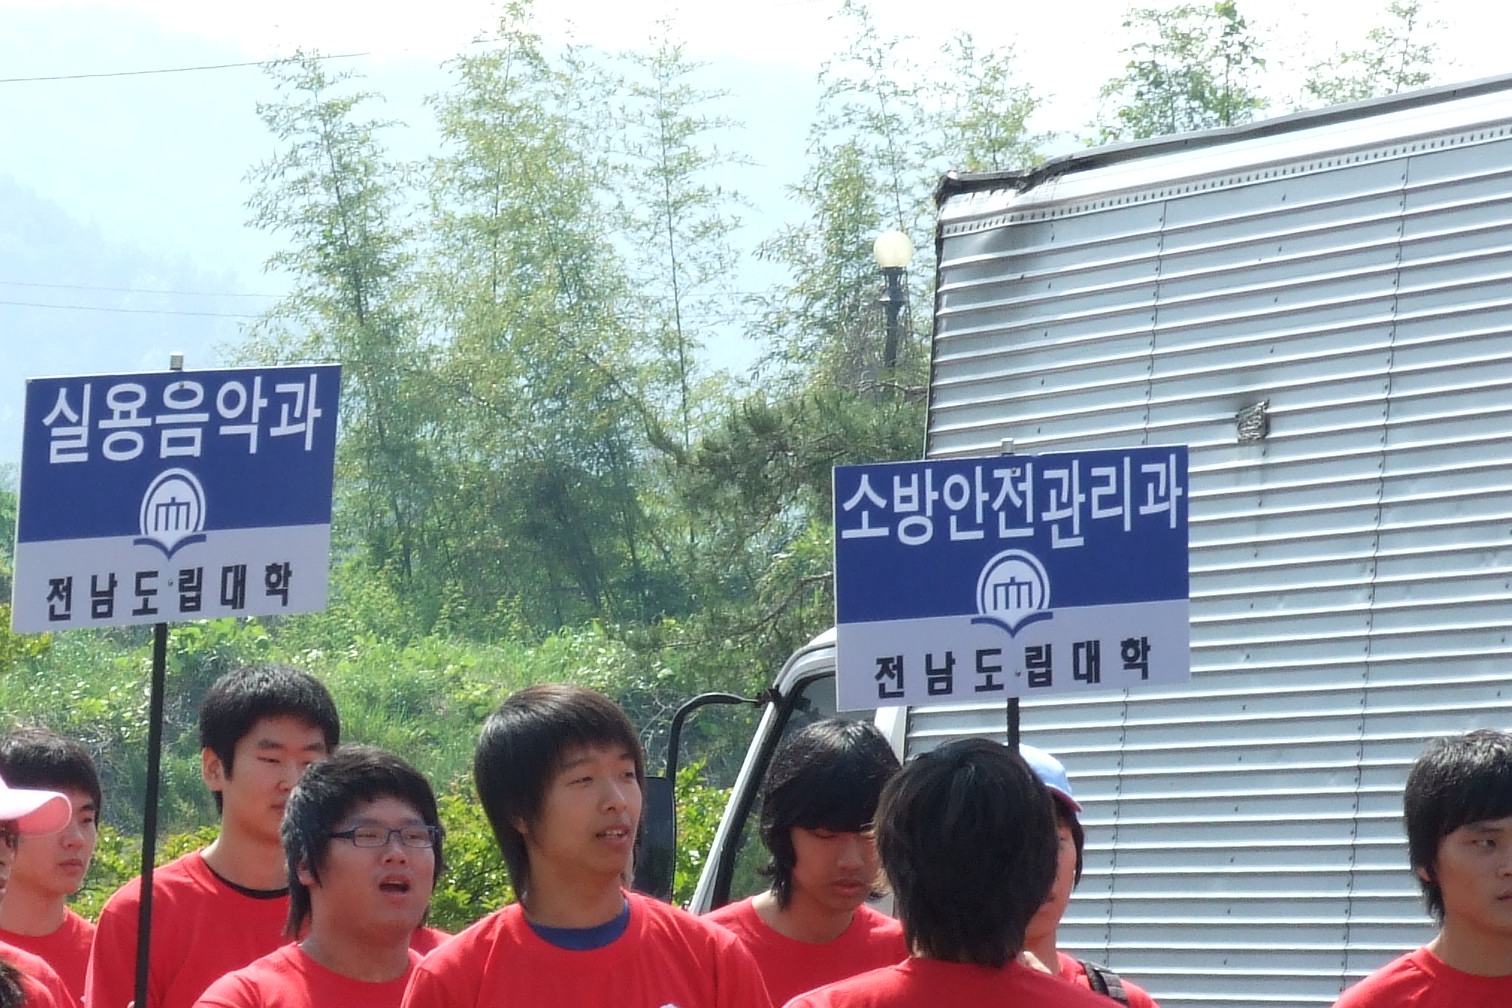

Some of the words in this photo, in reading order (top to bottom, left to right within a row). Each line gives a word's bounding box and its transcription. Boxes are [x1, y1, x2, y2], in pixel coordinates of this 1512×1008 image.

[42, 373, 323, 464] 실용음악과
[841, 453, 1183, 549] 소방안전관리과
[46, 562, 293, 622] 전남도립대학
[874, 636, 1152, 699] 전남도립대학
